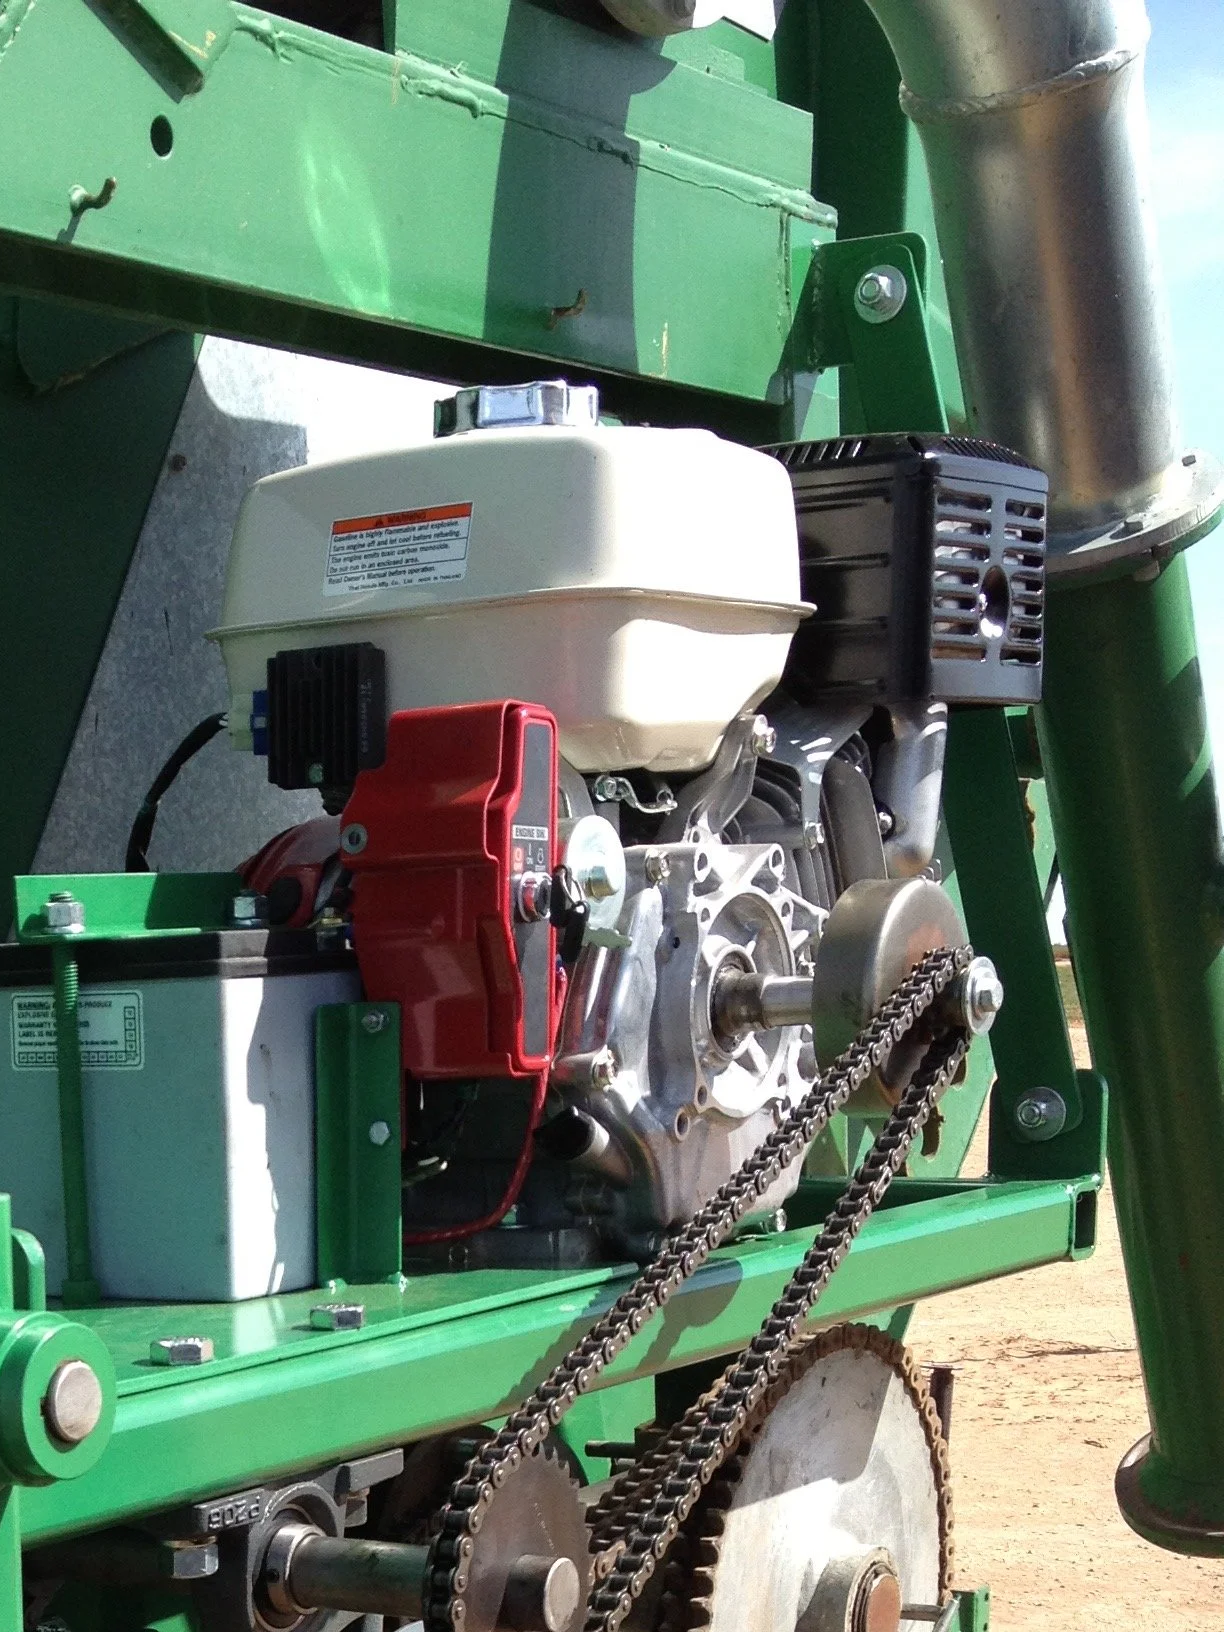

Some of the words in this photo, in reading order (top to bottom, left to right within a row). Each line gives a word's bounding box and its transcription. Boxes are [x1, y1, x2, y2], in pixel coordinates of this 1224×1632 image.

[376, 538, 388, 546] and
[397, 546, 417, 555] carbon
[376, 558, 403, 566] enclosed
[388, 567, 406, 577] before
[516, 828, 534, 837] ENGINE
